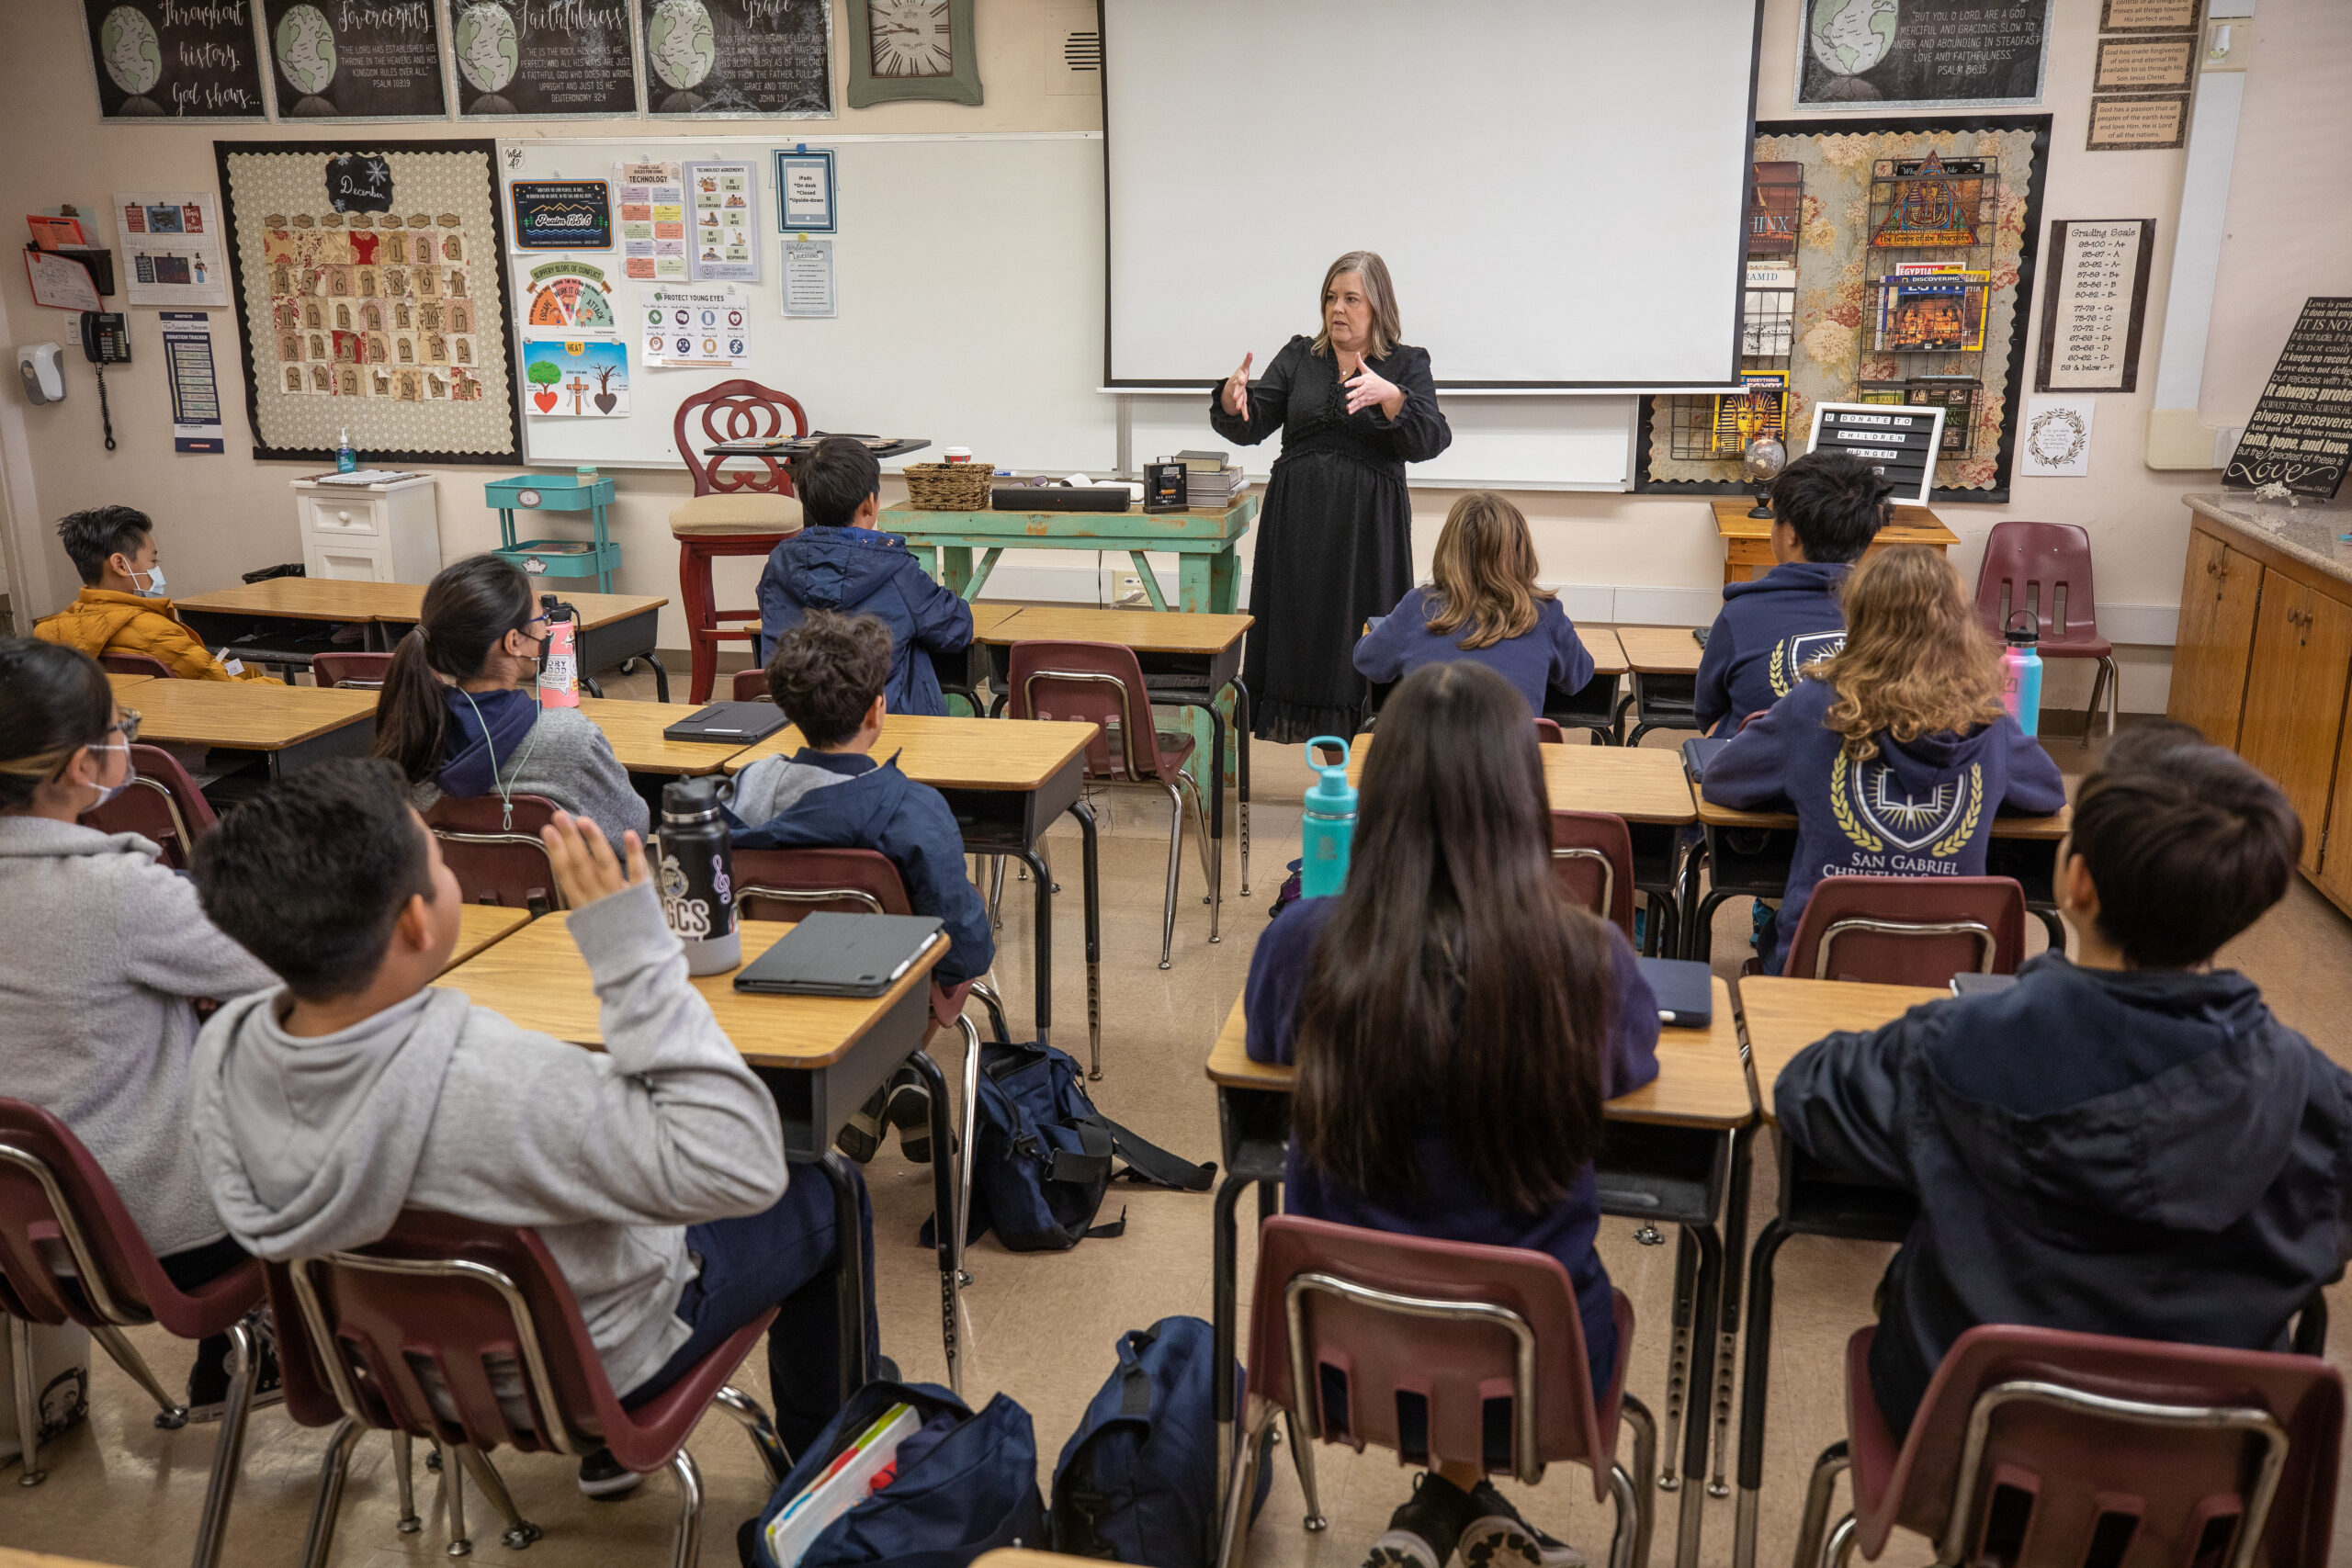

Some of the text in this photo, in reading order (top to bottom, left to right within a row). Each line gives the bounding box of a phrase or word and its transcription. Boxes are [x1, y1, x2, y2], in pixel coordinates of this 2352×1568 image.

[157, 0, 248, 29] Throughout
[338, 0, 435, 34] Sovereignty
[2135, 15, 2158, 23] perfect
[1900, 26, 1937, 36] MERCIFUL
[1939, 25, 1955, 35] AND
[1999, 23, 2021, 33] SLOW
[2025, 23, 2034, 32] TO
[1891, 36, 2041, 50] ANGER AND ABOUNDING IN STEADFAST
[1913, 52, 1932, 62] LOVE
[1935, 52, 1950, 62] AND
[2150, 47, 2185, 55] forgiveness
[1937, 65, 1962, 75] PSALM
[373, 79, 391, 88] PSALM
[172, 82, 201, 117] God
[759, 94, 775, 103] JOHN
[628, 175, 668, 184] TECHNOLOGY
[340, 175, 386, 199] December
[536, 213, 593, 227] Psalm 135:6
[1917, 234, 1924, 243] of
[2071, 228, 2136, 239] Grading Scale
[2114, 240, 2126, 248] A+
[394, 243, 458, 259] 1 2 3
[2113, 250, 2120, 258] A
[534, 266, 554, 279] SLIPPERY
[579, 265, 601, 279] CONFLICT
[278, 276, 463, 292] 4 5 6 7 8 9 10
[553, 287, 567, 298] WORK
[575, 288, 585, 298] OUT
[539, 299, 552, 321] ESCAPE
[586, 299, 605, 321] ATTACK
[2308, 299, 2335, 308] Love is
[284, 310, 465, 328] 11 12 13 14 15 16 17
[2309, 309, 2325, 317] does
[2297, 318, 2313, 330] IT
[2312, 319, 2326, 331] IS
[287, 343, 469, 360] 18 19 20 21 22 23 24
[568, 344, 582, 352] HEAT
[2287, 343, 2295, 351] it
[2297, 343, 2305, 351] is
[2325, 344, 2352, 355] easily
[2281, 353, 2290, 361] it
[2288, 353, 2312, 364] keeps
[2324, 355, 2350, 364] record
[2277, 363, 2297, 371] Love
[2298, 365, 2316, 373] does
[289, 373, 300, 386] 25
[317, 372, 327, 386] 26
[345, 373, 355, 387] 27
[403, 381, 413, 396] 29
[432, 380, 443, 394] 30
[462, 379, 472, 393] 31
[2271, 374, 2340, 385] but rejoices with
[2264, 382, 2320, 400] It always
[2259, 400, 2288, 410] ALWAYS
[2313, 404, 2343, 413] ALWAYS
[1842, 414, 1888, 423] DONATE
[2253, 409, 2293, 425] always
[2249, 423, 2267, 431] And
[2283, 425, 2302, 434] these
[2303, 427, 2324, 436] three
[1839, 432, 1904, 441] CHILDREN
[2242, 432, 2349, 455] faith, hope, and love.
[1848, 449, 1895, 457] HUNGER
[2236, 446, 2345, 466] But the greatest of these is
[2228, 446, 2338, 485] Love
[1851, 852, 1886, 868] SAN
[1891, 854, 1959, 875] GABRIEL
